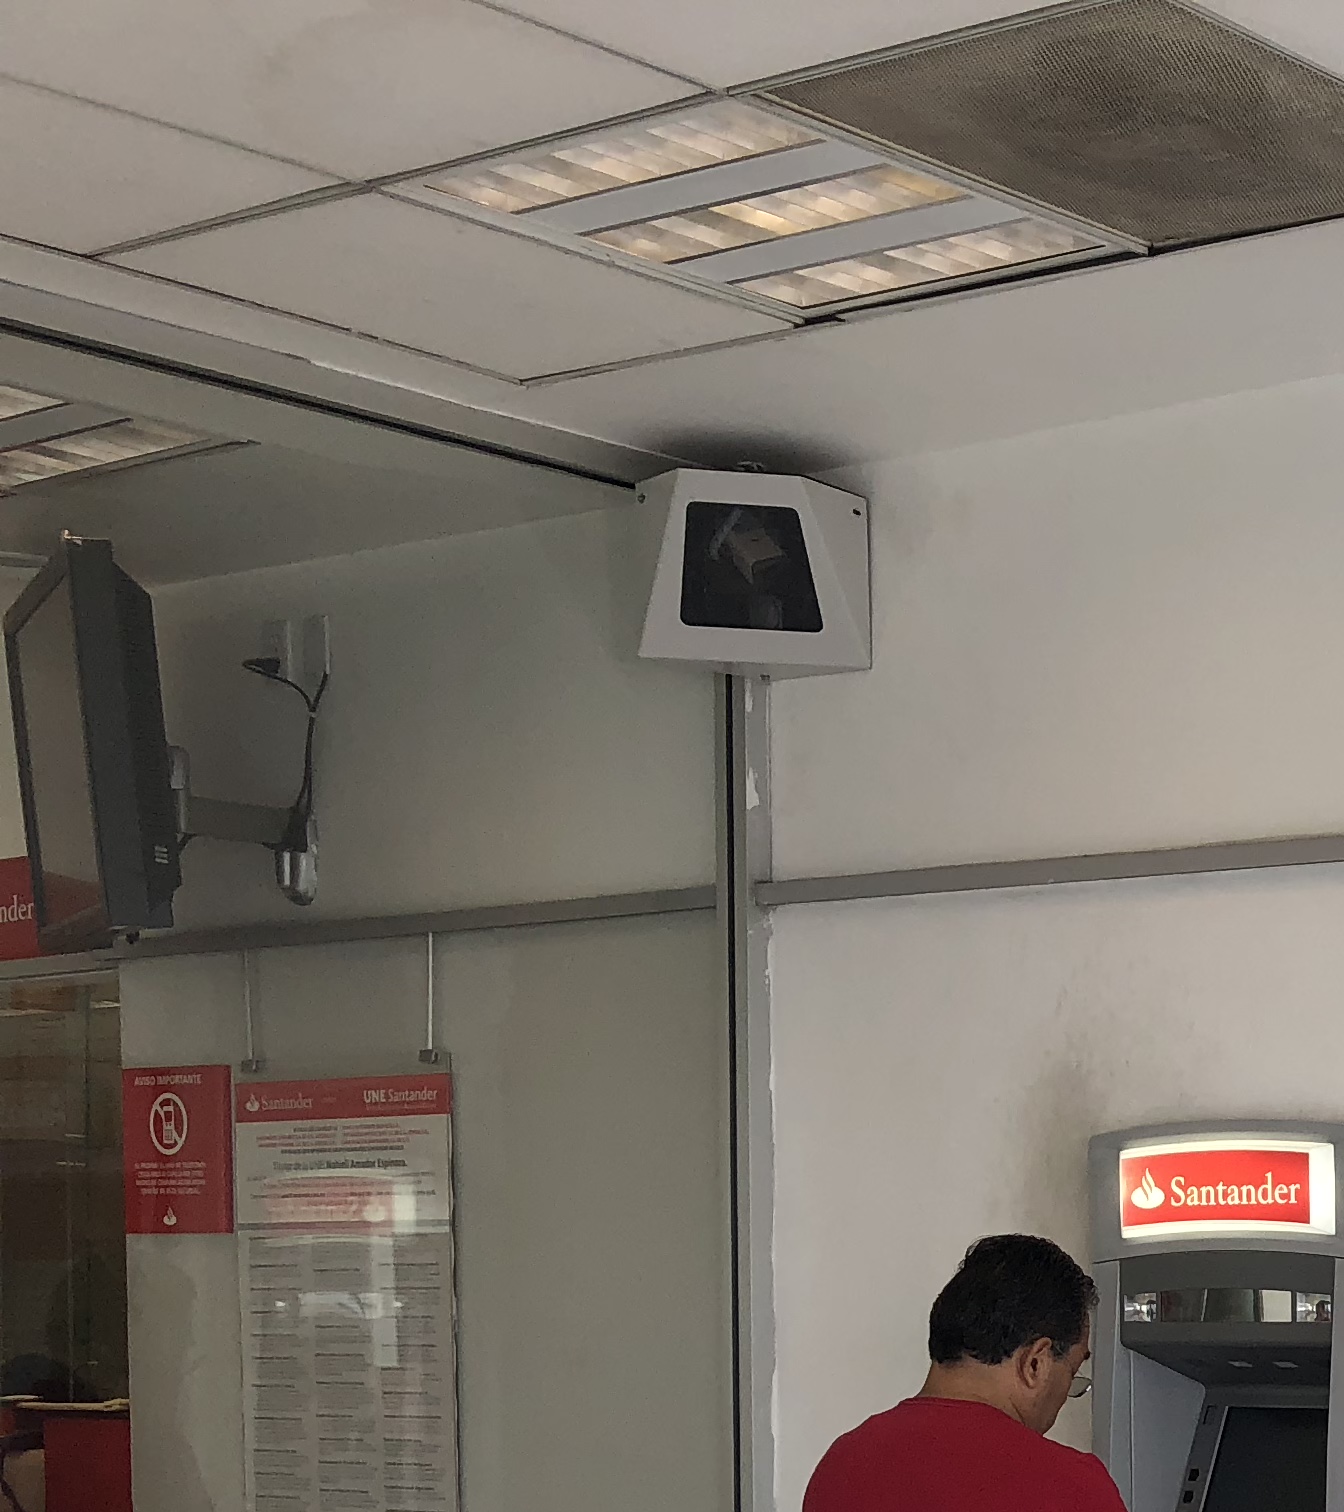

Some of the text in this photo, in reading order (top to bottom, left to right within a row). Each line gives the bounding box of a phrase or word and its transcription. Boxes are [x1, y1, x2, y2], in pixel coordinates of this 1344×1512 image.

[134, 1074, 202, 1086] AVISO IMPORTANTE
[262, 1093, 313, 1110] Santander
[363, 1086, 438, 1103] UNE Santander
[1170, 1171, 1301, 1207] Santander
